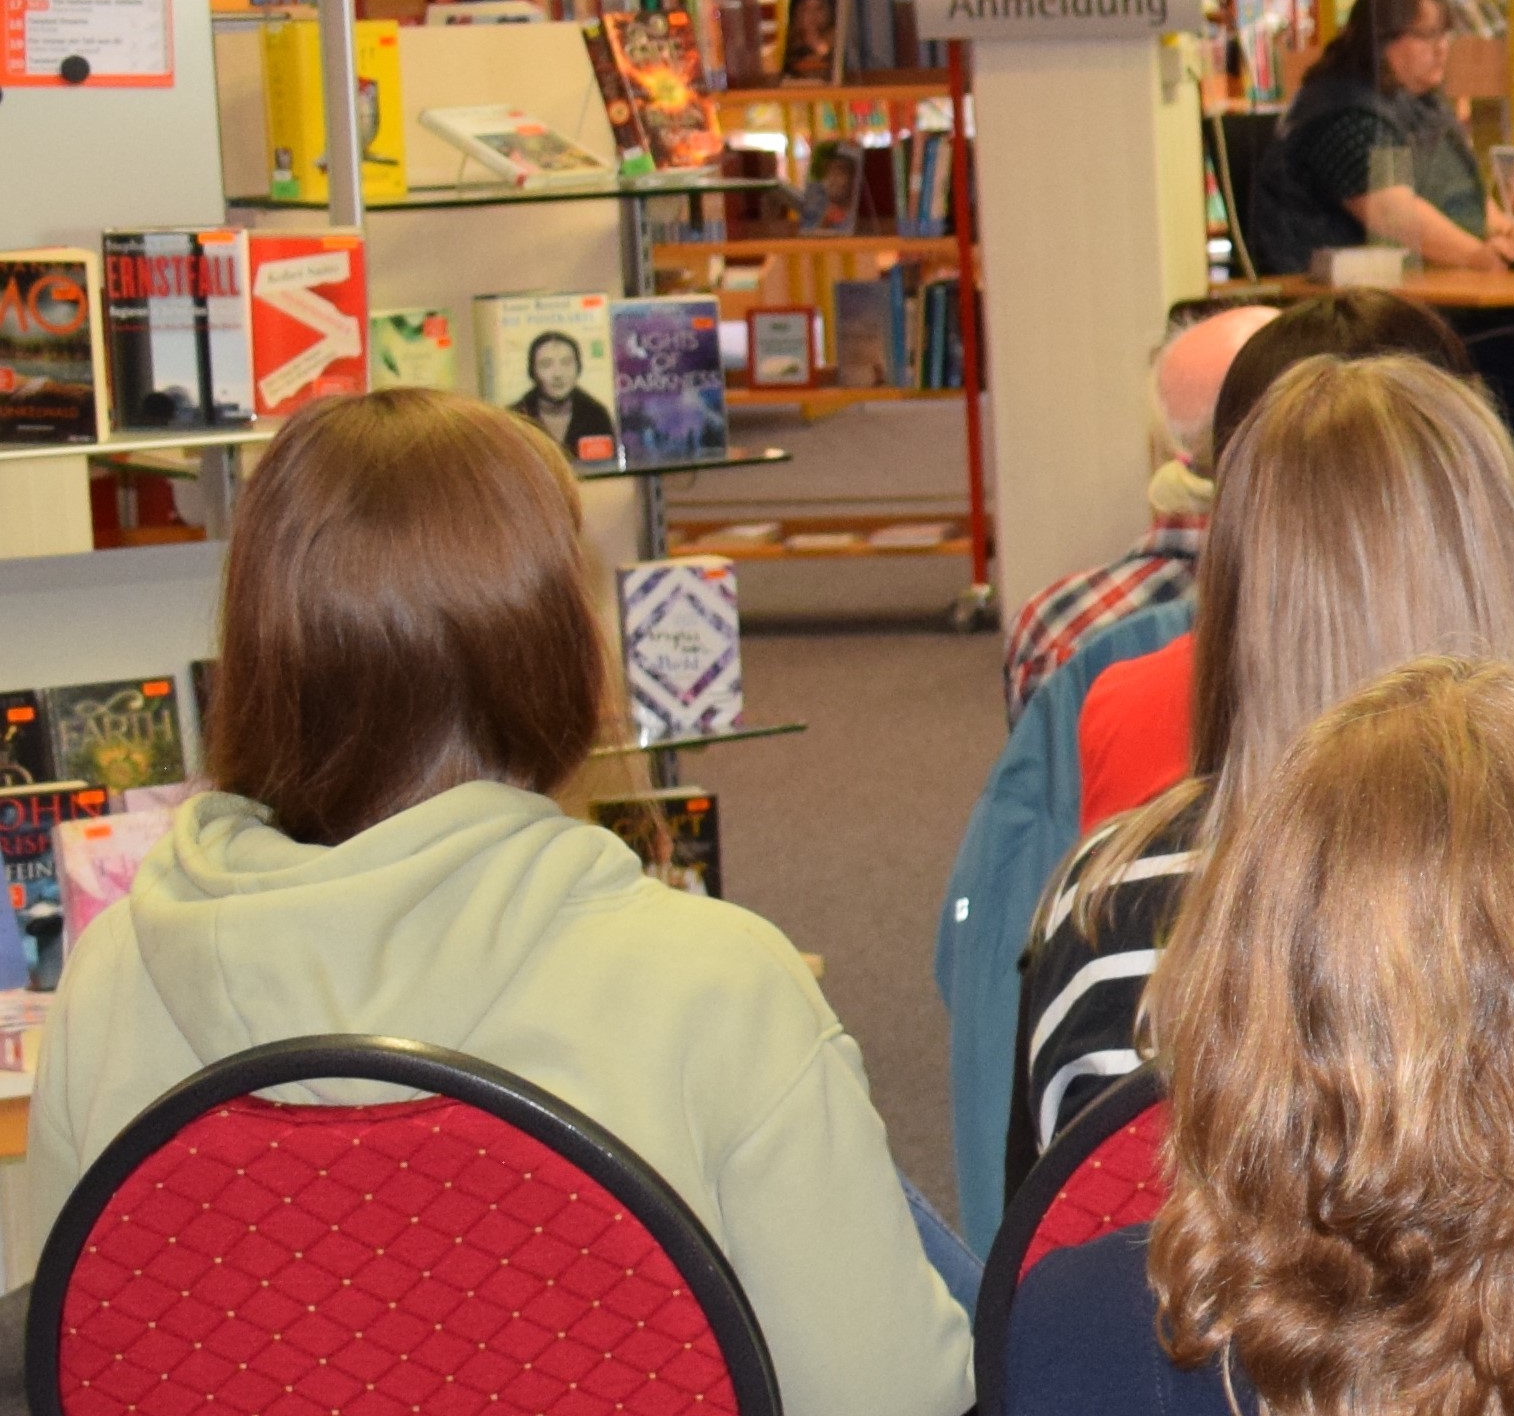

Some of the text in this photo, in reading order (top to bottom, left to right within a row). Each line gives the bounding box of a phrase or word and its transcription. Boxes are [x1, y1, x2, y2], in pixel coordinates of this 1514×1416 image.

[107, 255, 242, 298] ERNSTFALL
[59, 708, 173, 747] EARTH
[0, 791, 105, 830] OHN
